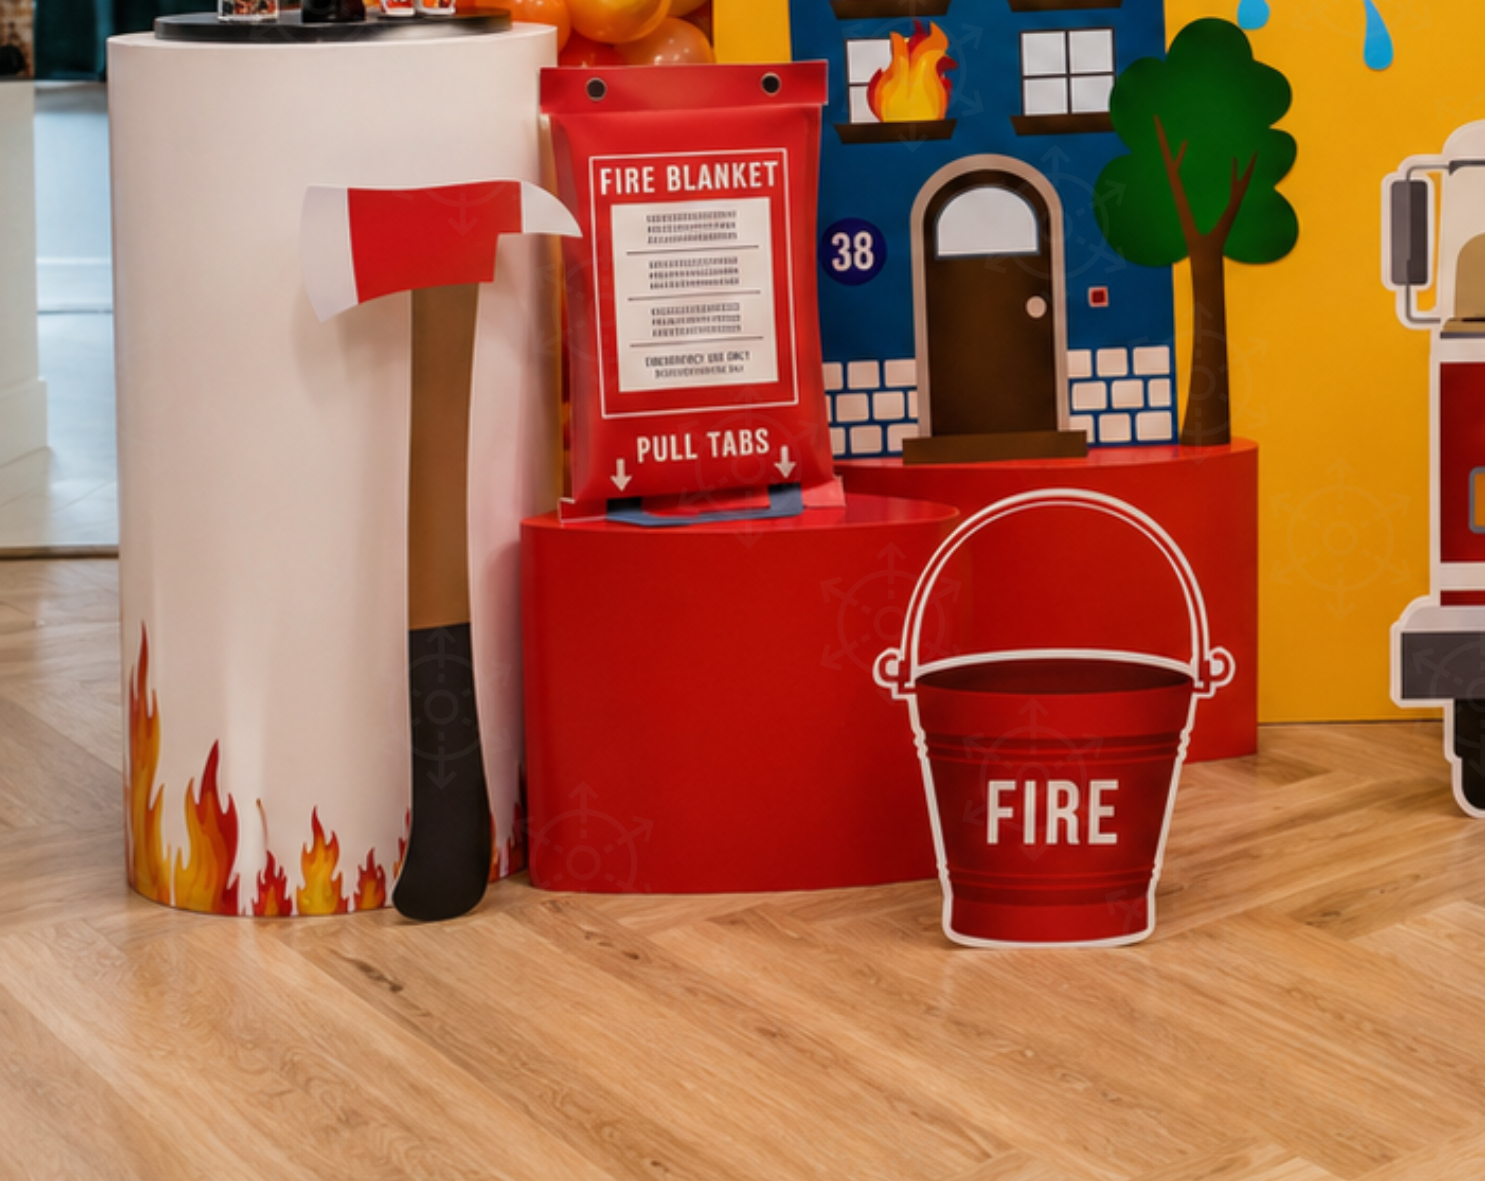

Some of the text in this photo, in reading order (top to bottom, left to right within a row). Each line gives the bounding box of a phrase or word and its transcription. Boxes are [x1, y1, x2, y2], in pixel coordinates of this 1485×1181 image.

[600, 160, 779, 195] FIRE BLANKET
[831, 231, 874, 272] 38
[637, 428, 770, 463] PULL TABS
[987, 779, 1119, 845] FIRE
